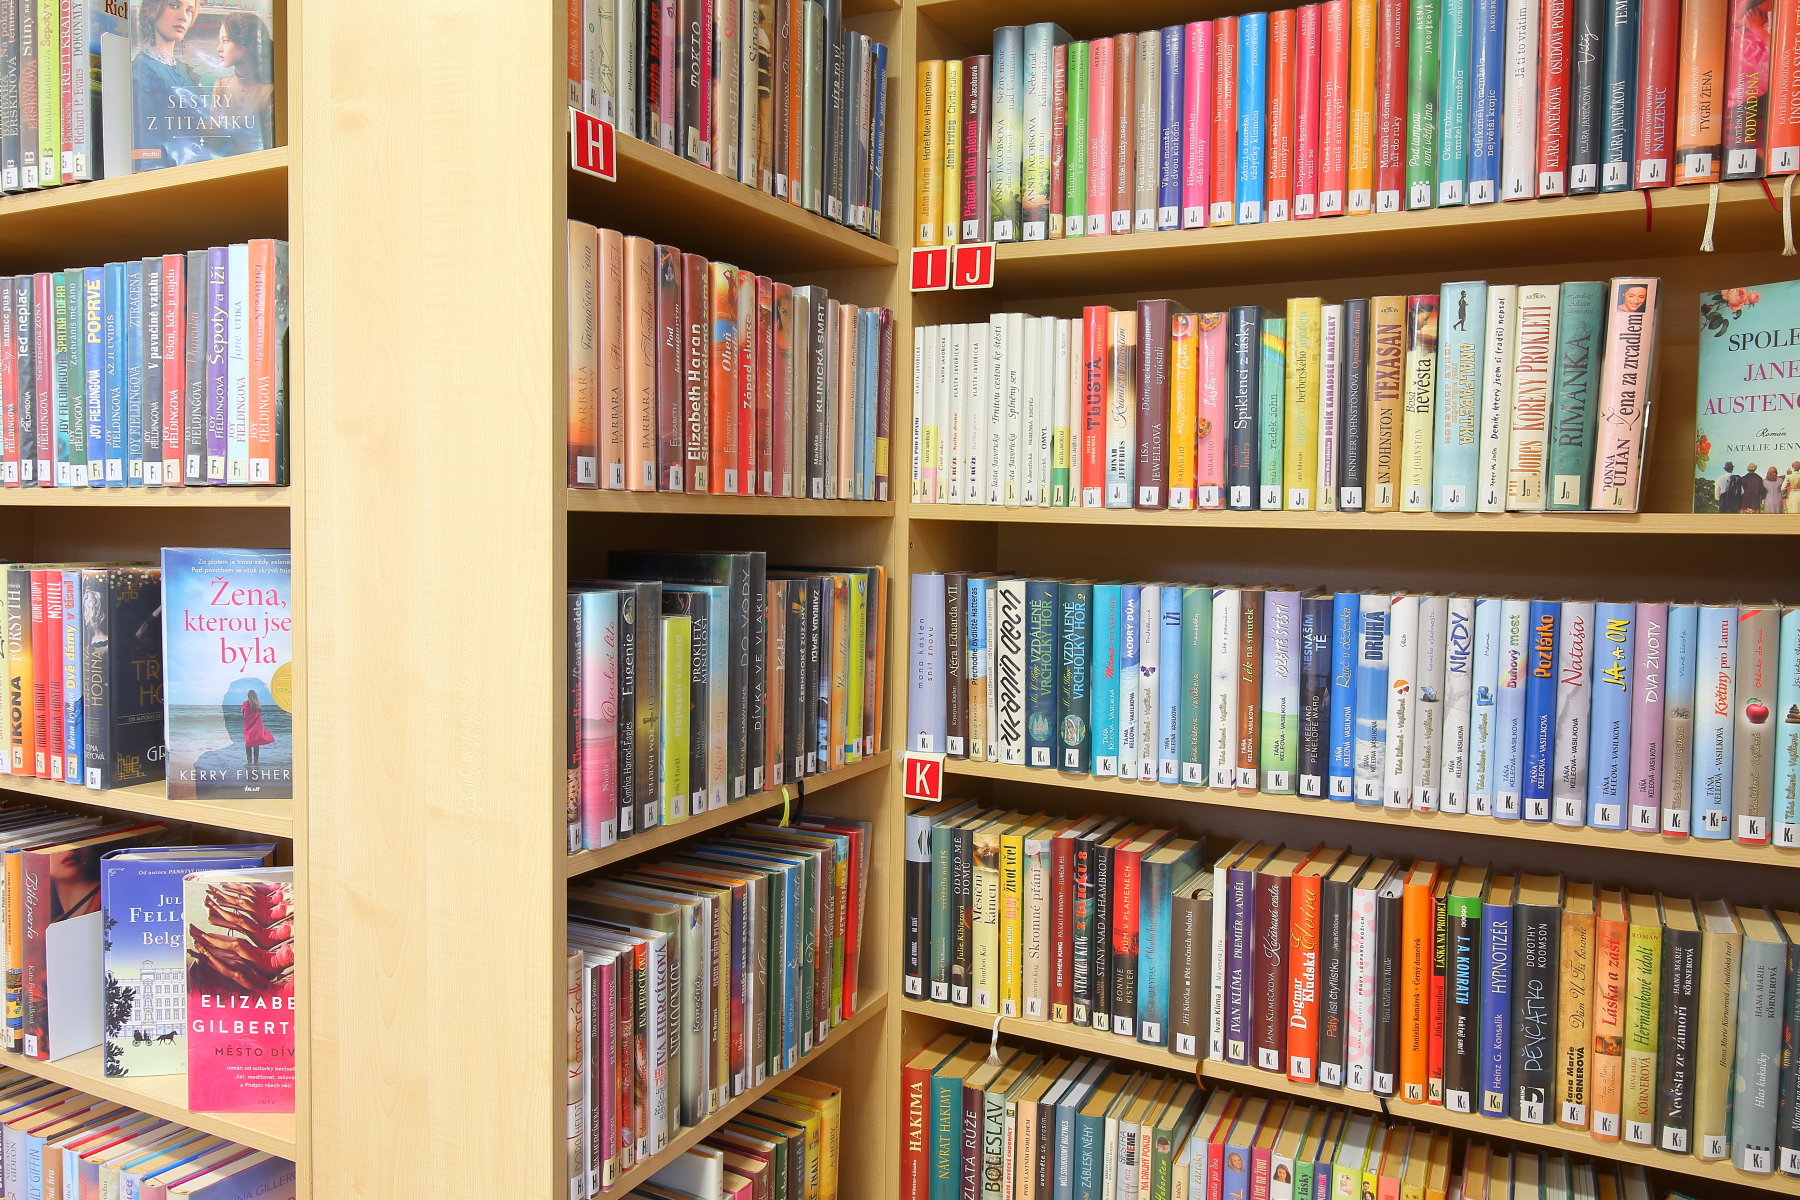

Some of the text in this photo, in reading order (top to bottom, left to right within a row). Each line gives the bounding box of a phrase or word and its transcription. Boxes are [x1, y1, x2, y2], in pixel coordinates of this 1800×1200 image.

[22, 15, 34, 56] Stíny
[72, 2, 83, 57] DOKONALÝ
[1416, 5, 1424, 29] ALENA
[1423, 3, 1434, 53] JAKOUBKOVÁ
[74, 68, 84, 95] Evans
[690, 21, 701, 87] TOKIO
[9, 56, 18, 136] ERSKINOVÁ
[168, 94, 233, 109] SESTRY
[922, 71, 934, 160] Hotel New Hampshire
[969, 65, 978, 114] Kate Jacobsová
[1699, 70, 1712, 132] TYGŘÍ ŽENA
[1745, 71, 1759, 142] PODVÁDĚNÁ
[73, 109, 84, 145] Richard
[147, 115, 255, 130] Z TITANIKU
[587, 119, 604, 171] H
[1410, 113, 1422, 166] Pod lampou
[1423, 102, 1434, 166] není vždy tma
[1547, 87, 1562, 167] KLÁRA JANEČKOVÁ
[1654, 88, 1666, 151] NALEZENEC
[921, 167, 932, 217] John Irving
[964, 120, 979, 217] Páteční klub pletení
[166, 269, 177, 296] najdu
[580, 244, 593, 274] žena
[927, 254, 932, 285] I
[966, 250, 981, 282] J
[1, 289, 10, 347] mamce pusu
[86, 279, 101, 343] POPRVÉ
[128, 272, 140, 327] ZTRACENÁ
[148, 272, 158, 308] vztahů
[166, 310, 174, 327] kde
[209, 265, 228, 365] Šepoty a lži
[17, 289, 30, 359] Teď neplač
[148, 311, 161, 359] pavučině
[165, 331, 176, 360] Řekni,
[1235, 319, 1254, 353] lásky
[743, 315, 753, 409] Západ slunce
[814, 348, 824, 412] KLINICKÁ
[1240, 357, 1248, 365] z
[1374, 324, 1402, 401] TEXASAN
[1512, 306, 1551, 431] KOŘENY PROKLETÍ
[1601, 313, 1643, 431] Žena za zrcadlem
[1743, 359, 1800, 382] JANE
[88, 370, 102, 439] JOY FIELDINGOVÁ
[611, 387, 619, 444] BARBARA
[688, 324, 701, 460] Elizabeth Haran
[1008, 386, 1019, 419] Splněný
[1086, 357, 1101, 430] TLUSTÁ
[1553, 335, 1591, 447] ŘÍMANKA
[1140, 442, 1148, 463] LISA
[1151, 424, 1161, 481] JEWELLOVÁ
[1348, 373, 1359, 480] JENNIFER JOHNSTONOVÁ
[1510, 440, 1543, 476] Jones
[184, 610, 257, 631] kterou
[210, 576, 287, 608] Žena,
[740, 569, 749, 667] DO VODY
[8, 590, 22, 661] FORSYTH
[66, 625, 77, 660] dámy
[220, 637, 277, 673] byla
[1063, 602, 1074, 666] VZDÁLENÉ
[1074, 603, 1085, 699] VRCHOLKY HOR
[1124, 599, 1135, 658] MODRÝ DŮM
[1363, 611, 1385, 660] DRUHÁ
[1450, 612, 1470, 673] NIKDY
[1561, 615, 1585, 686] Nataša
[66, 664, 76, 689] Dvě
[91, 650, 102, 706] HODINA
[623, 634, 634, 696] Eugenie
[673, 634, 684, 737] Nejlepší víkend
[752, 593, 763, 730] DÍVKA VE VLAKU
[1643, 621, 1661, 703] DVA ŽIVOTY
[11, 676, 22, 744] IKONA
[180, 770, 290, 781] KERRY FISHER
[623, 721, 633, 803] Cynthia Harrod-Eagles
[916, 762, 931, 795] K
[1029, 869, 1043, 959] Skromné přání
[1074, 935, 1089, 995] STEPHEN KING
[1302, 952, 1315, 1003] Kludská
[1491, 921, 1507, 994] HYPNOTIZÉR
[653, 943, 667, 1066] IVA HERCÍKOVÁ
[1290, 978, 1307, 1030] Dagmar
[1520, 979, 1547, 1071] DĚVČÁTKO
[1634, 947, 1652, 1046] Heřmánkové údolí
[215, 1045, 263, 1056] MĚSTO
[909, 1081, 923, 1152] HAKIMA
[937, 1087, 951, 1179] NÁVRAT HAKIMY
[985, 1100, 1003, 1192] BOLESLAV
[30, 1149, 40, 1182] GIFFIN
